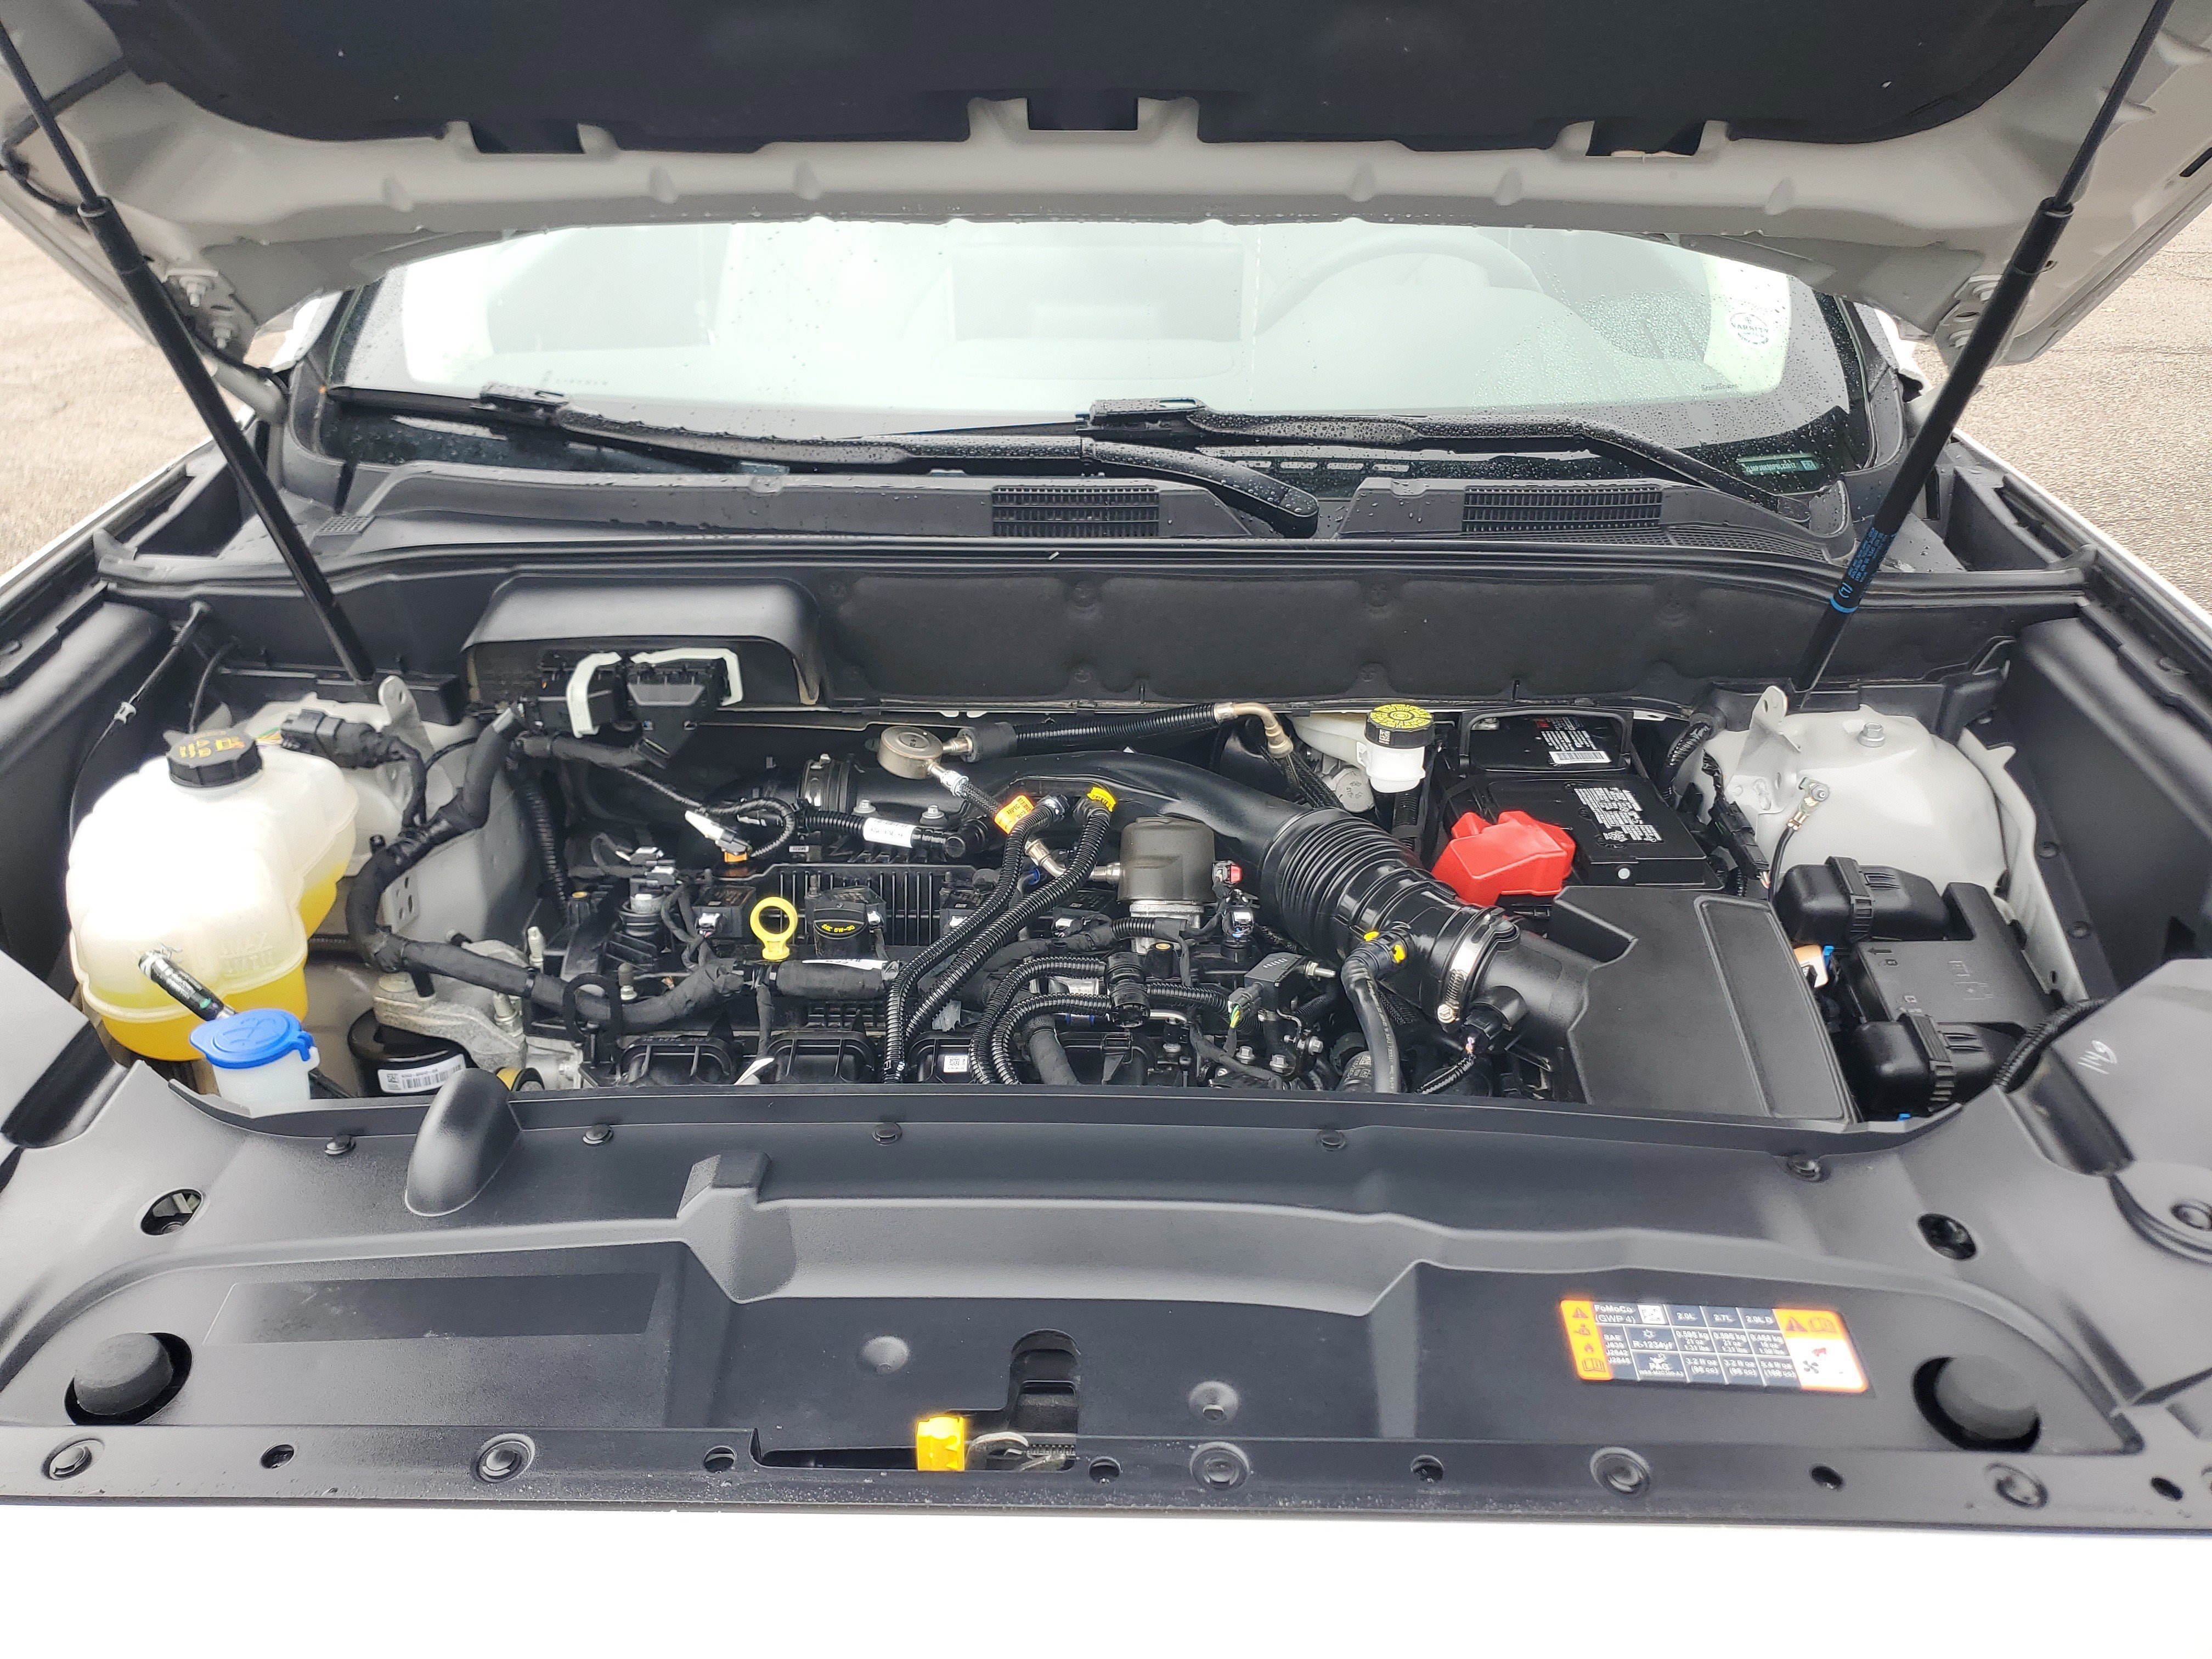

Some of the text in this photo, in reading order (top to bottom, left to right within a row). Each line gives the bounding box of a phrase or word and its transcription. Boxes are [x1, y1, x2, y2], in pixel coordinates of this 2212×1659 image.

[1593, 1304, 1634, 1313] FoMoCo
[1595, 1314, 1635, 1324] (GWP 4)
[1676, 1312, 1697, 1321] 2.0L
[1713, 1314, 1735, 1322] 2.7L
[1697, 1331, 1709, 1340] kg
[1632, 1340, 1673, 1350] R-1234yf
[1648, 1362, 1671, 1370] PAG
